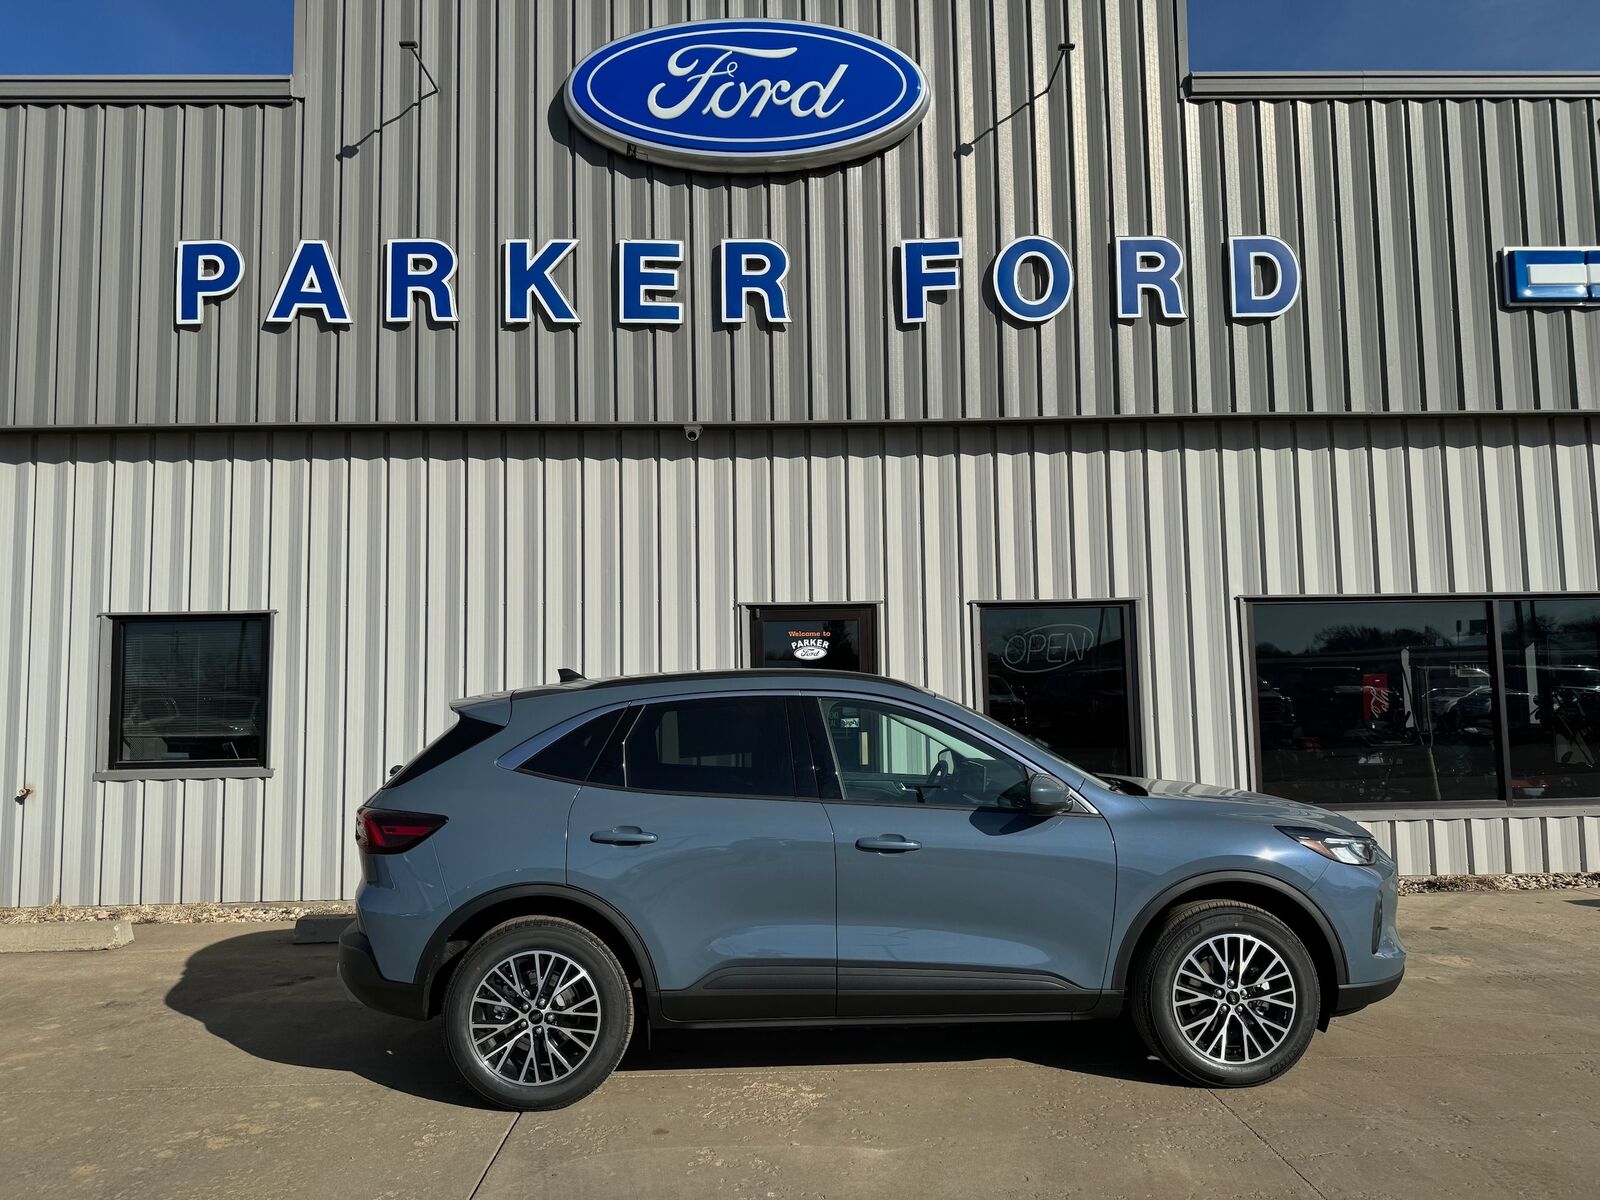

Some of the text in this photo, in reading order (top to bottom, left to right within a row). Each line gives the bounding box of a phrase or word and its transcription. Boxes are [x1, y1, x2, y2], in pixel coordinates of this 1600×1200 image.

[647, 44, 849, 120] Ford
[175, 235, 1301, 325] PARKER FORD
[791, 639, 829, 649] PARKER
[1005, 633, 1085, 664] OPEN
